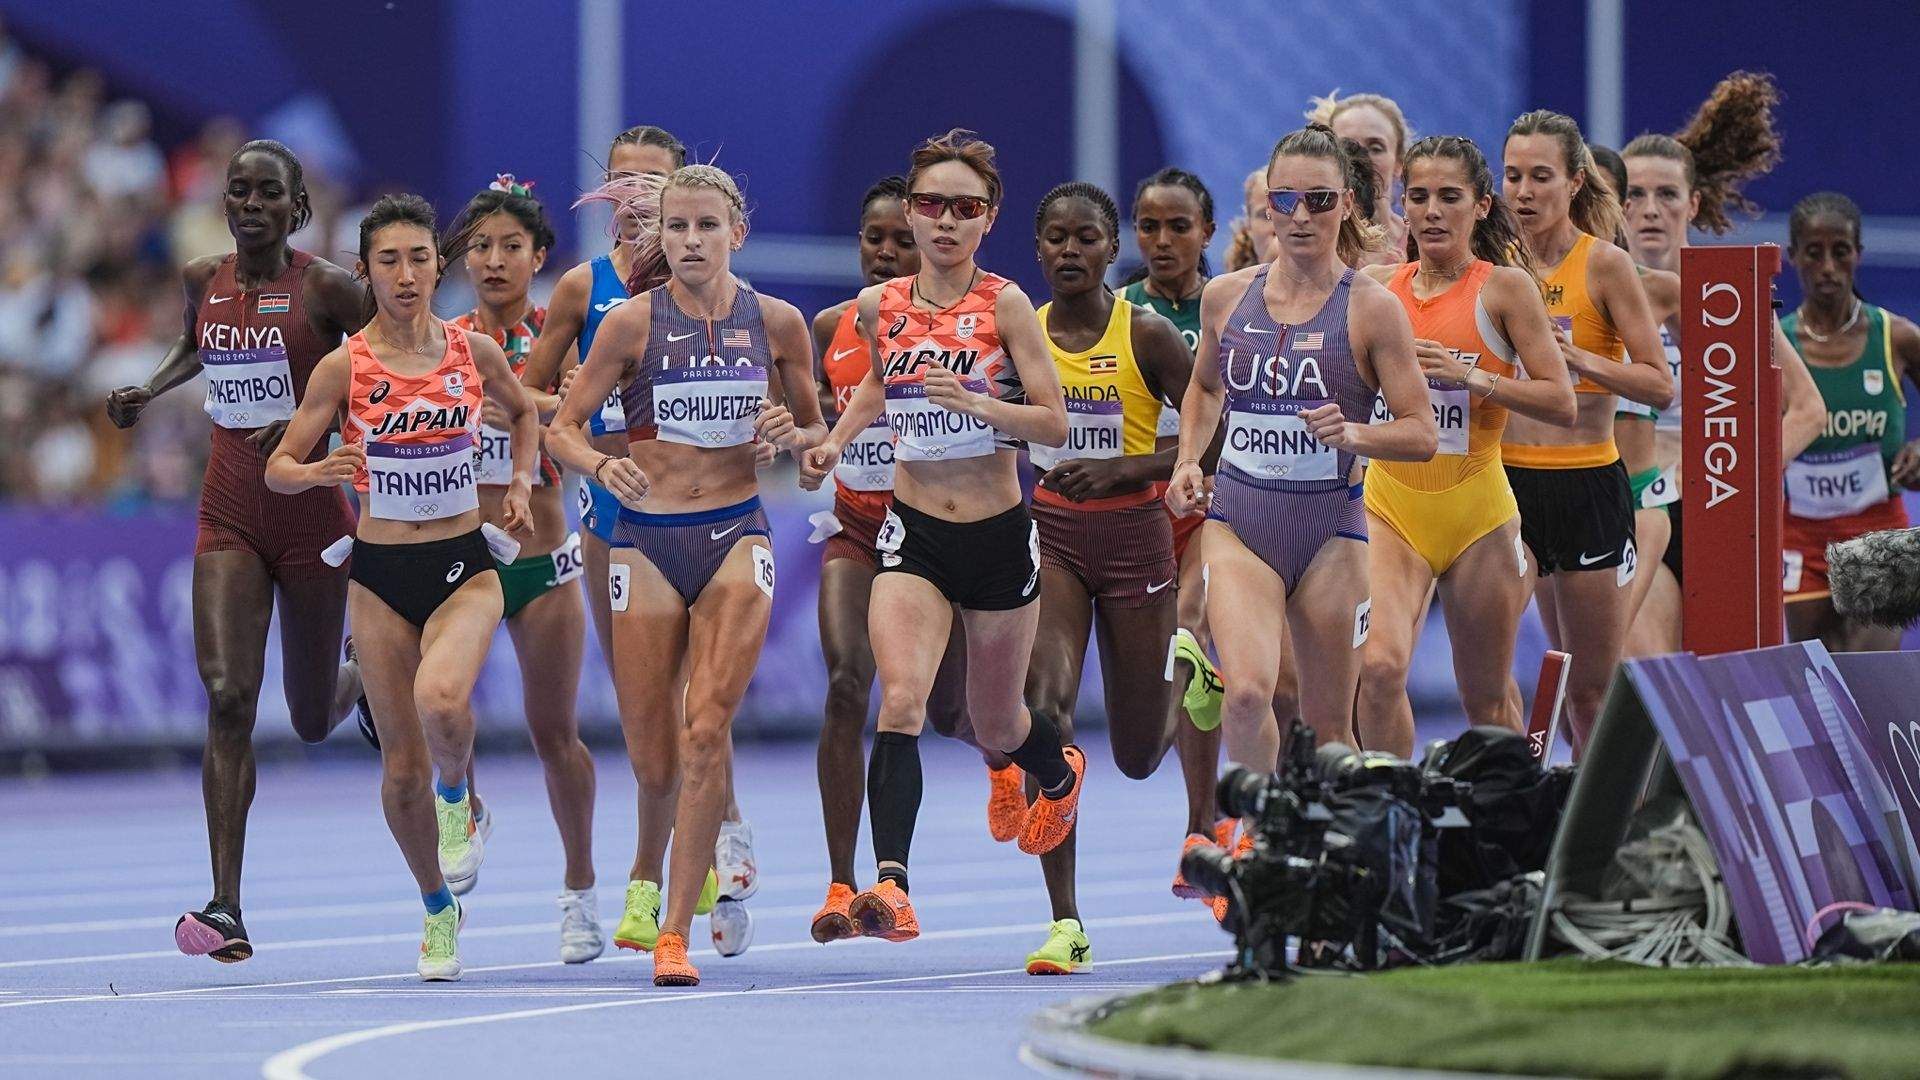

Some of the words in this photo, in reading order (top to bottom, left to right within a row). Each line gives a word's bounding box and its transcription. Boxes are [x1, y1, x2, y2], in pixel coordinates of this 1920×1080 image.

[201, 321, 285, 351] KENYA
[232, 352, 257, 361] 2024
[682, 370, 712, 378] PARIS
[715, 369, 741, 377] 2024
[1227, 348, 1329, 398] USA
[372, 405, 469, 436] JAPAN
[1067, 401, 1093, 411] 2024
[1251, 402, 1276, 411] PARIS
[1703, 342, 1740, 510] OMEGA
[1821, 409, 1888, 437] IOPIA
[394, 447, 422, 455] PARIS
[425, 445, 450, 454] 2024
[1230, 426, 1330, 455] CRANN
[371, 462, 472, 497] TANAKA
[1806, 471, 1863, 498] TAYE
[761, 559, 774, 588] 15
[1529, 729, 1546, 758] GA
